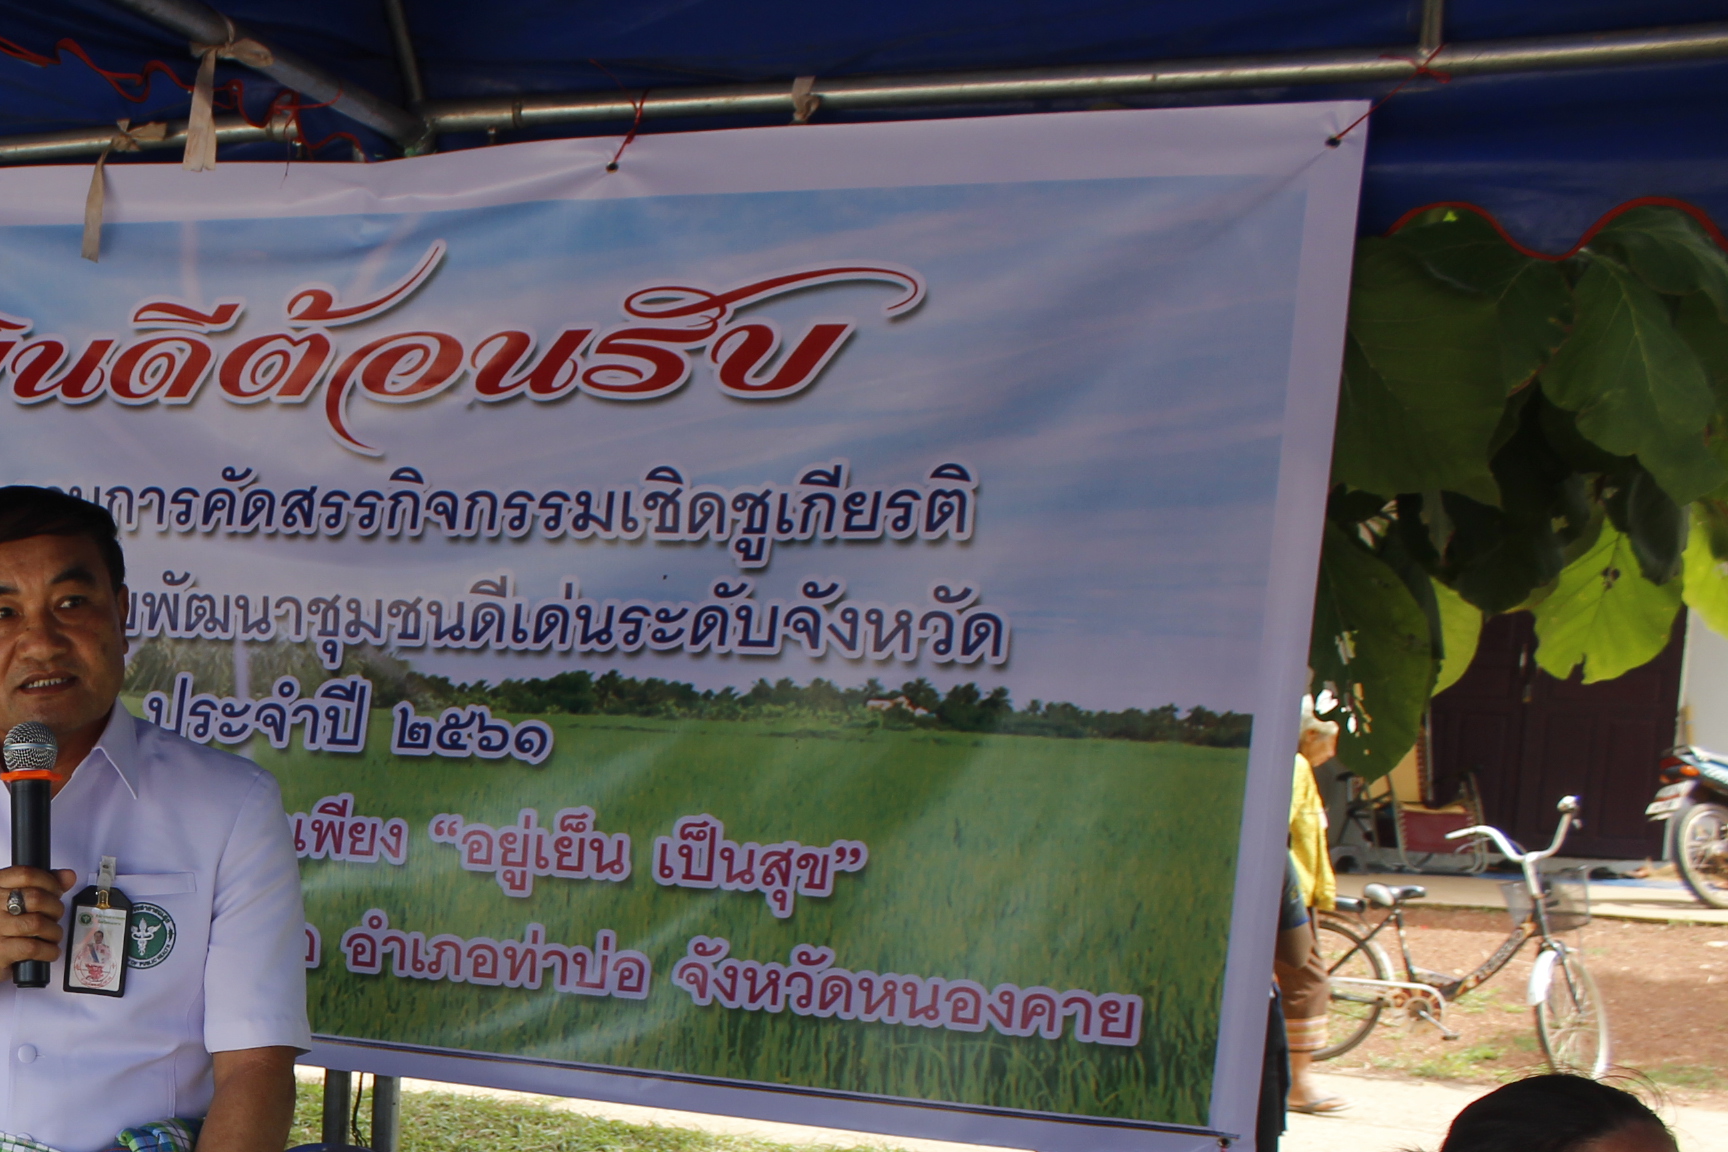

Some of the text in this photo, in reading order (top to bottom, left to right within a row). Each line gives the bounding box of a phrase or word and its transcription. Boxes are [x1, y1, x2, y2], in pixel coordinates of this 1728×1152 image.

[148, 676, 548, 759] ประจำปี ๒๕๖๑
[294, 799, 403, 859] เพียง
[346, 914, 1136, 1041] อำเภอท่าบ่อ จังหวัดหนองคาย
